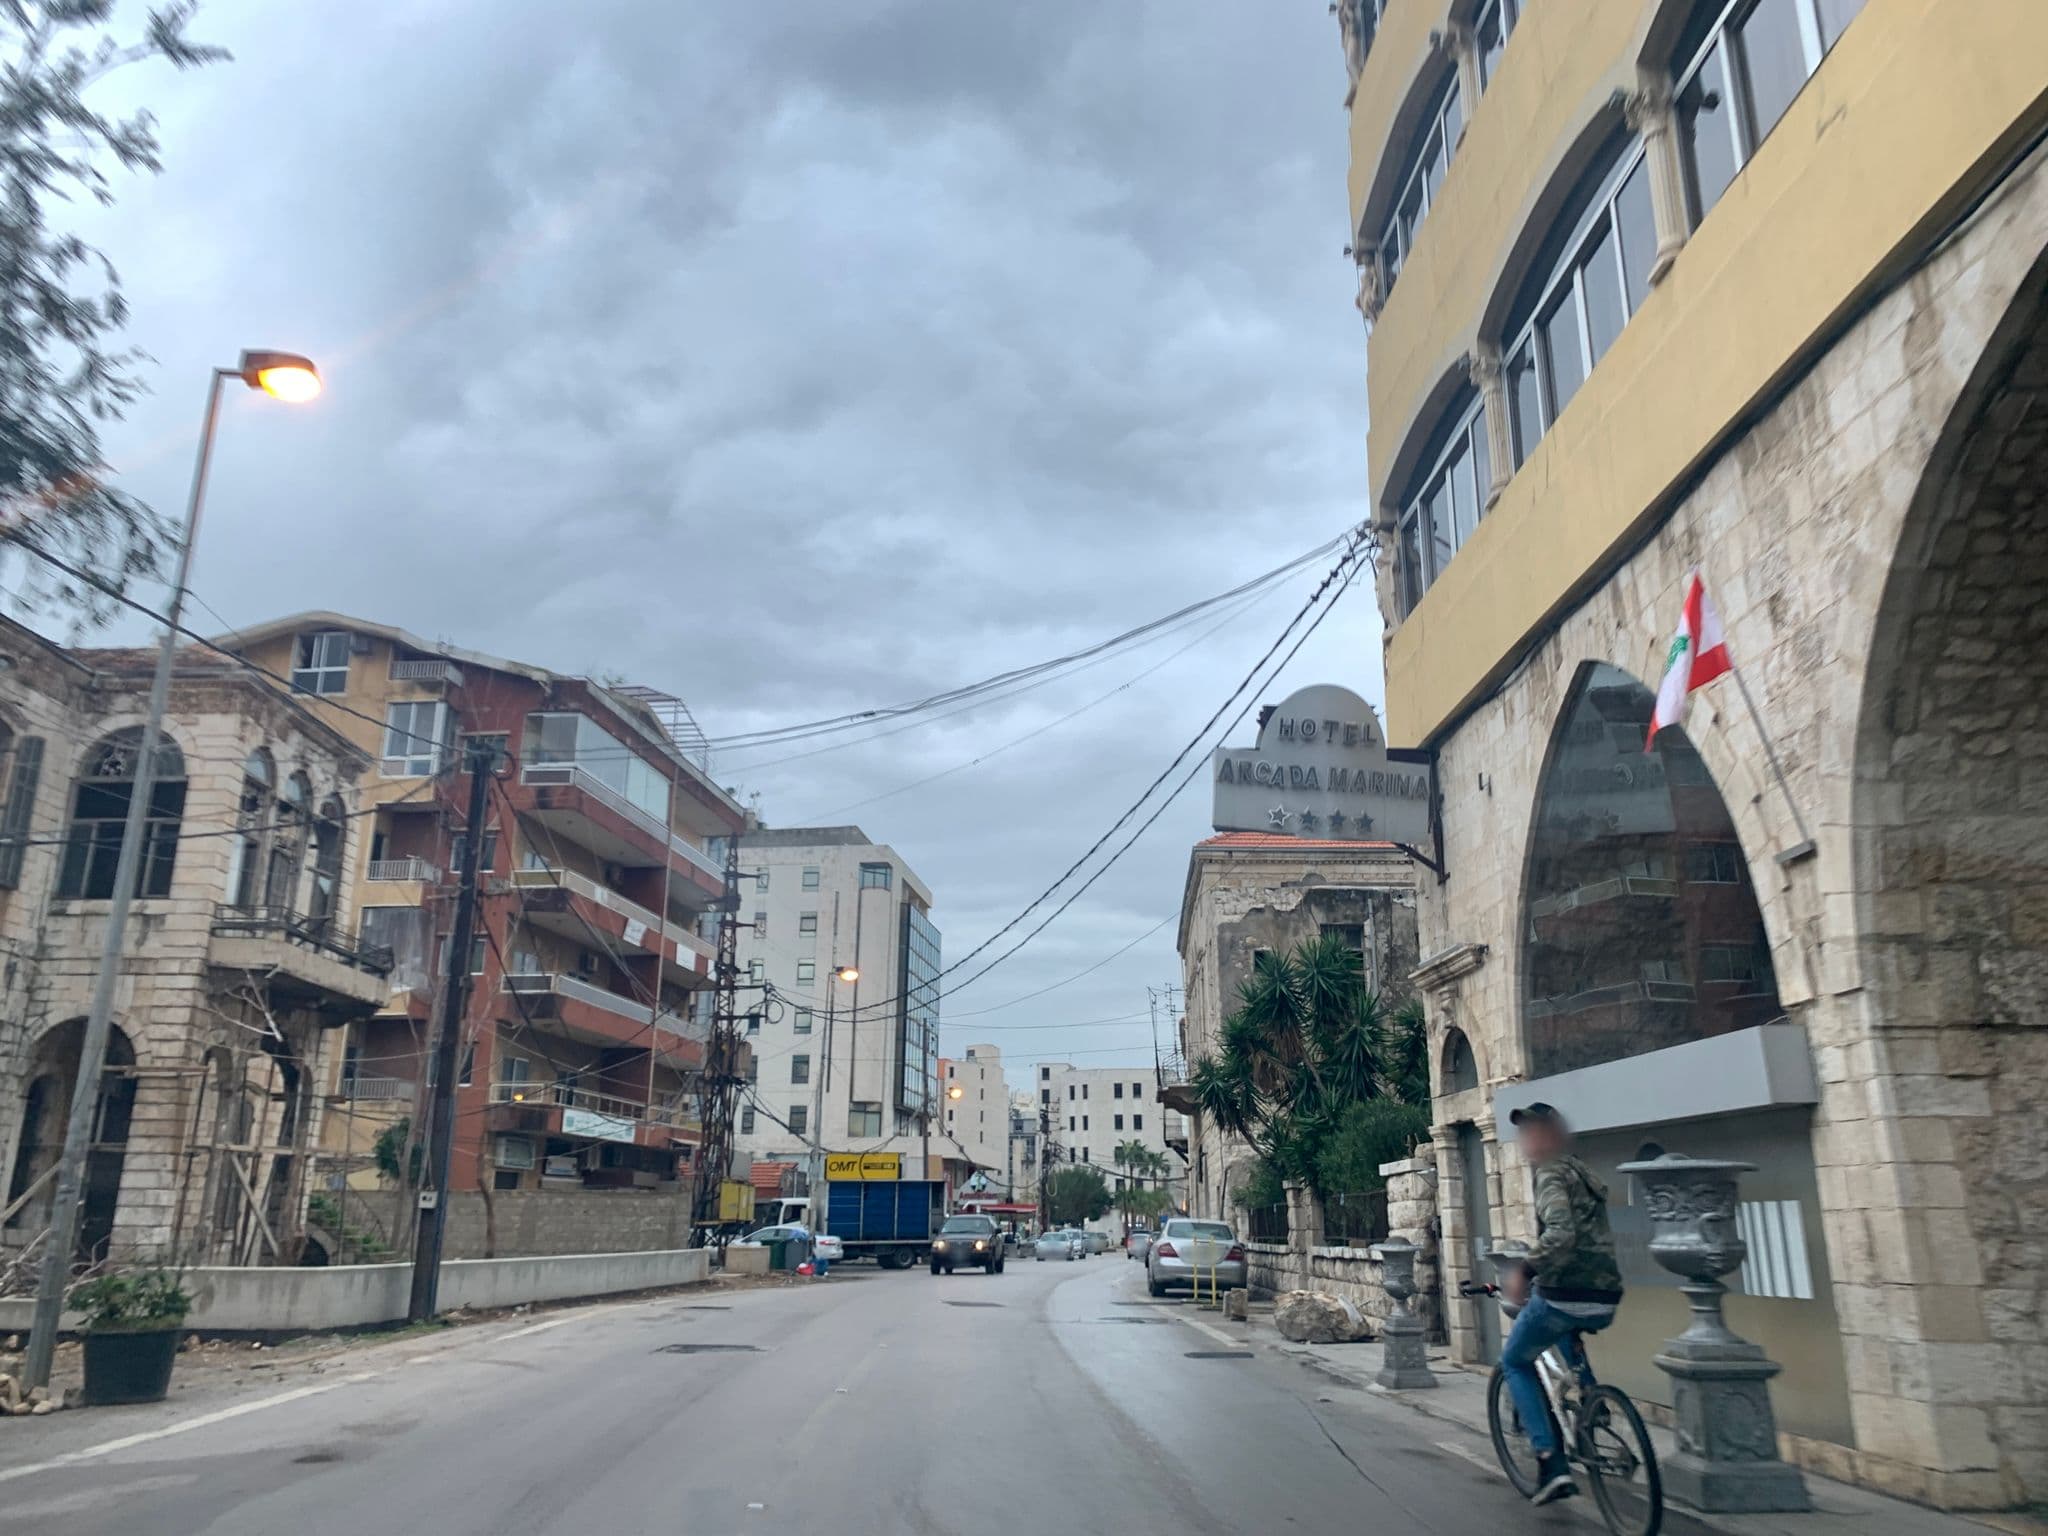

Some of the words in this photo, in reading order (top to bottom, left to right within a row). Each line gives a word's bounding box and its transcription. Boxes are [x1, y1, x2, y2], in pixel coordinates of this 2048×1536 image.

[1279, 717, 1377, 744] HOTEL
[1217, 758, 1319, 789] ARCADA
[1328, 768, 1428, 801] MARINA
[829, 1161, 857, 1172] OMT
